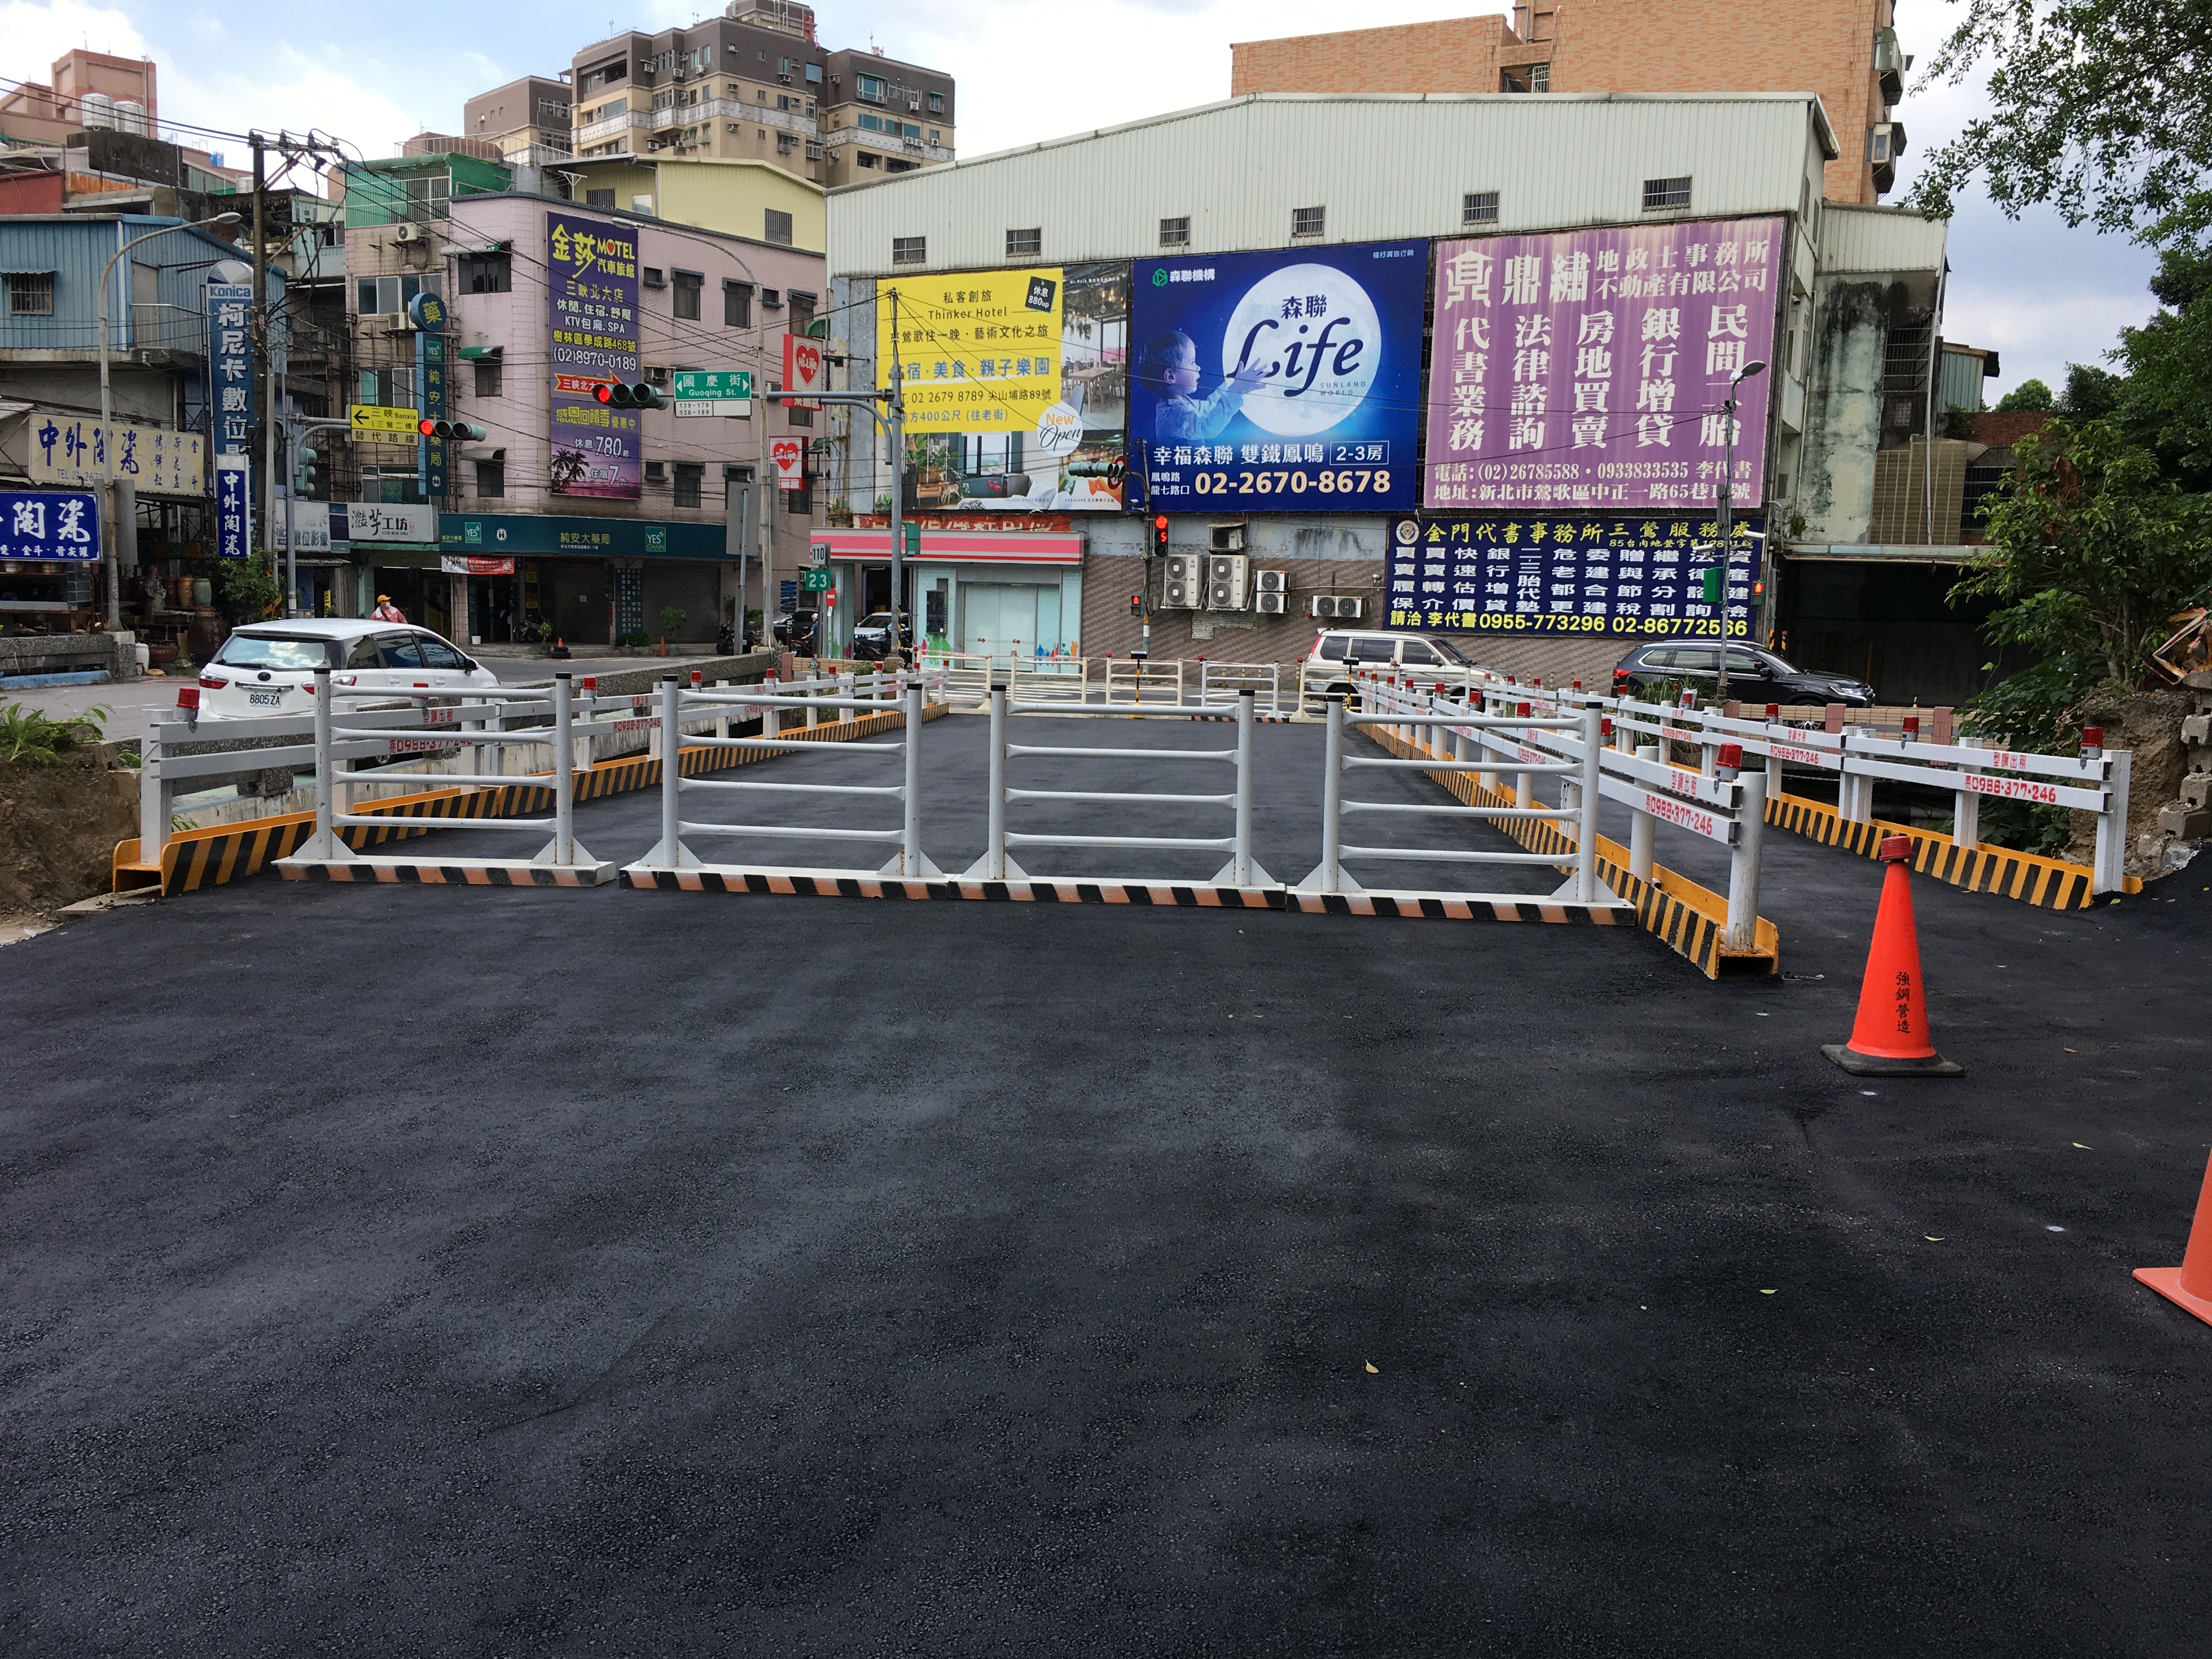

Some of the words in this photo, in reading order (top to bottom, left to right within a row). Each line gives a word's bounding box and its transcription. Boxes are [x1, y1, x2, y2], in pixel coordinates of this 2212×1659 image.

[552, 224, 596, 278] 金莎
[597, 238, 635, 260] MOTEL
[1596, 239, 1770, 272] 地政士事務所
[597, 258, 635, 279] 汽車旅館
[1169, 268, 1215, 283] 森聯機構
[210, 285, 251, 298] Konica
[566, 280, 624, 303] 三峽北大店
[1034, 285, 1048, 297] 休息
[1594, 267, 1768, 300] 不動產有限公司
[943, 290, 992, 304] 私客創旅
[1028, 295, 1049, 309] 880up
[1280, 294, 1327, 319] 森聯
[422, 300, 442, 324] 藥
[928, 308, 972, 320] Thinker
[976, 306, 1008, 318] Hotel
[553, 347, 637, 371] (02)8970-0189
[1226, 317, 1364, 397] Life
[683, 374, 741, 388] 國慶街
[1448, 317, 1491, 451] 代書業務
[1509, 314, 1552, 450] 法律諮詢
[1571, 310, 1615, 449] 房地買賣
[1634, 307, 1681, 448] 銀行增貸
[689, 389, 722, 398] Guoqing
[912, 392, 924, 403] 02
[928, 391, 953, 403] 2679
[958, 390, 984, 402] 8789
[988, 388, 1052, 401] 尖山埔路89號
[371, 408, 393, 419] 三峽
[394, 412, 416, 420] Sanxia
[966, 409, 1008, 422] (往老街)
[1046, 413, 1075, 425] New
[354, 430, 415, 444] 替代路線
[1039, 423, 1082, 452] Open
[1153, 445, 1233, 466] 幸福森聯
[1240, 443, 1324, 465] 雙鐵鳳鳴
[1336, 444, 1383, 462] 2-3房
[57, 469, 69, 479] TEL
[1151, 472, 1180, 482] 鳳鳴路
[1695, 460, 1753, 479] 李代書
[1150, 485, 1189, 496] 龍七路口
[1195, 470, 1391, 494] 02-2670-8678
[0, 498, 91, 543] 陶瓷
[223, 471, 241, 555] 中外陶瓷
[560, 532, 611, 545] 純安大藥局
[812, 548, 825, 561] 110
[809, 573, 827, 588] 23
[1392, 546, 1416, 609] 買賣履保
[1421, 547, 1446, 610] 買賣轉介
[1452, 547, 1478, 611] 快速估價
[1484, 548, 1510, 612] 銀行增貸
[1549, 549, 1577, 613] 危老都更
[1582, 549, 1611, 614] 委建合建
[1616, 549, 1645, 616] 贈與節稅
[1650, 550, 1679, 617] 繼承分割
[1390, 610, 1422, 627] 請洽
[1427, 611, 1477, 628] 李代書
[1479, 613, 1606, 632] 0955-773296
[1993, 752, 2027, 770] 型鋼出租
[1671, 770, 1697, 795] 型鋼出租
[1895, 971, 1911, 1034] 強鋼營造
